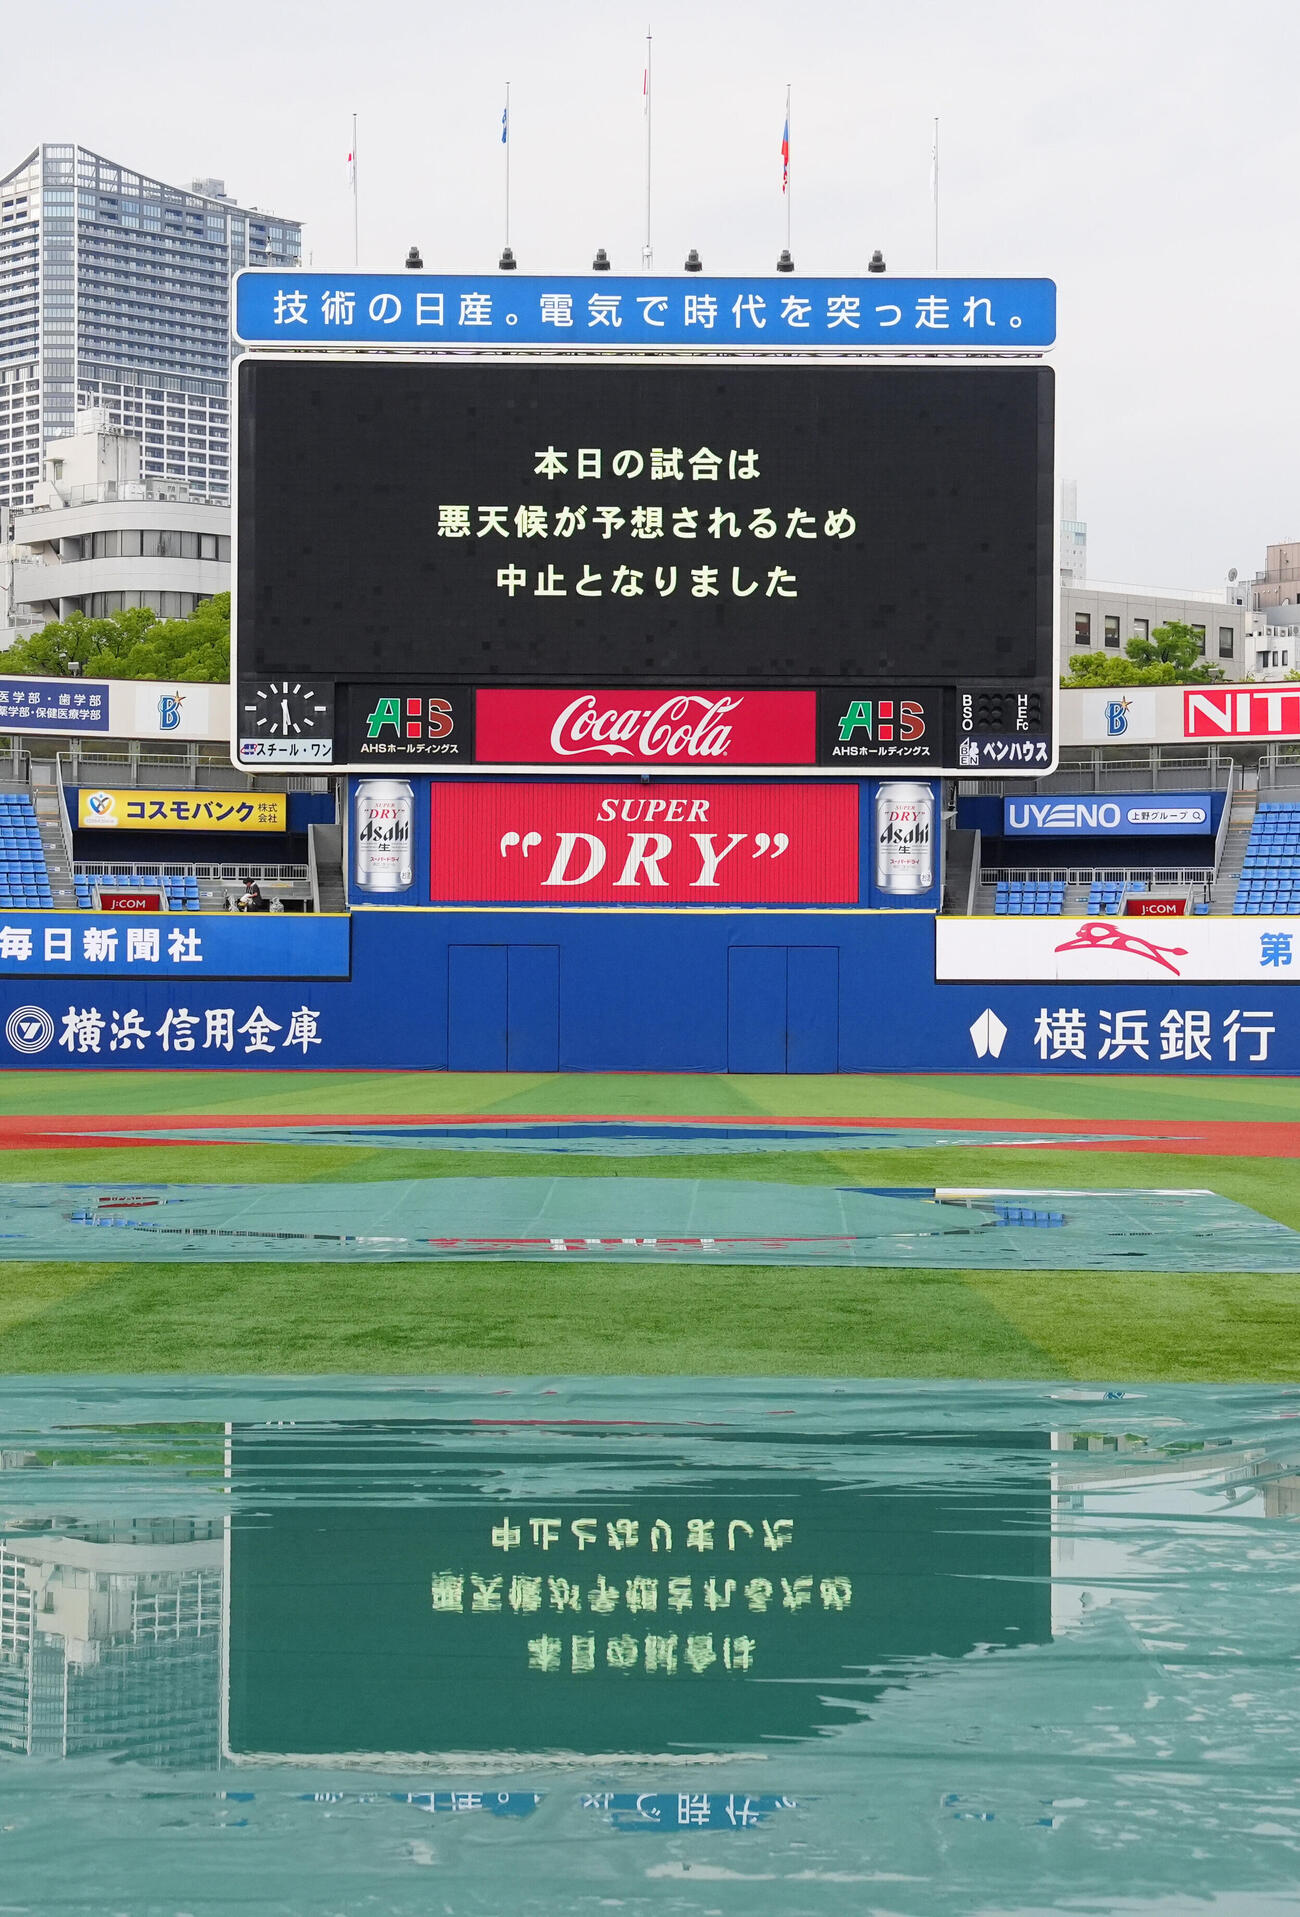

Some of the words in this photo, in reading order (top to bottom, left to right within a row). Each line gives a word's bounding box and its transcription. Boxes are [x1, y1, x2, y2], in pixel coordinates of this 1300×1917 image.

[273, 289, 1022, 329] 技術の日産。電気で時代を突っ走れ。
[534, 446, 761, 480] 本日の試合は
[437, 504, 857, 539] 悪天候が予想されるため
[497, 563, 799, 598] 中止となりました
[366, 698, 454, 738] AHS
[550, 695, 744, 757] Coca-Cola
[838, 701, 926, 741] AHS
[256, 743, 332, 757] スチール・ワン
[360, 743, 459, 754] AHSホールディングス
[832, 746, 930, 756] AHSホールディングス
[127, 801, 254, 822] コスモバンク
[258, 803, 278, 812] 株式
[596, 799, 710, 822] SUPER
[1009, 803, 1121, 828] UYENO
[1131, 811, 1189, 821] 上野グループ
[258, 814, 278, 824] 会社
[360, 820, 409, 841] Asahi
[880, 822, 929, 844] Asahi
[378, 843, 391, 852] 生
[898, 845, 911, 855] 生
[111, 899, 146, 910] J:COM
[1141, 904, 1177, 915] J:COM
[0, 926, 203, 963] 毎日新聞社
[1259, 932, 1293, 967] 第
[58, 1005, 323, 1054] 横浜信用金庫
[1034, 1008, 1276, 1061] 横浜銀行
